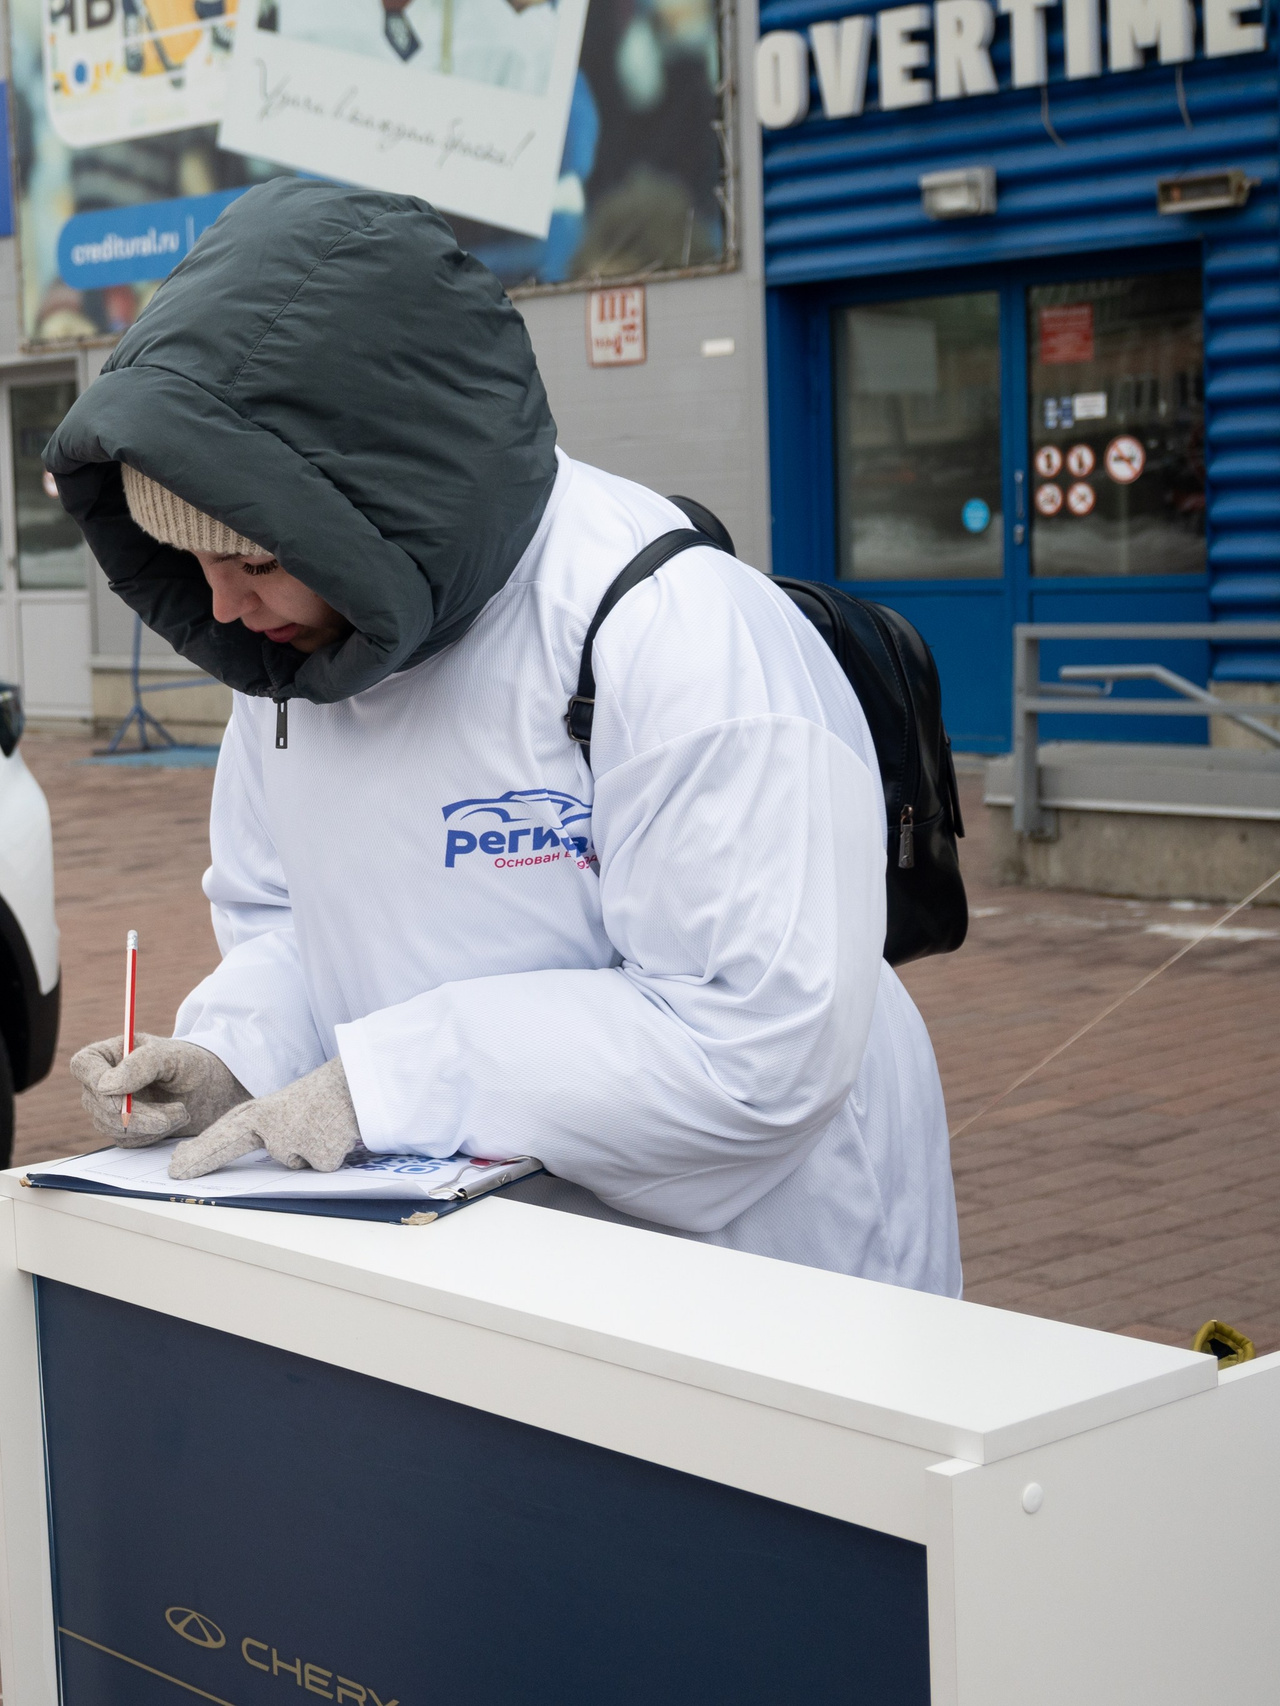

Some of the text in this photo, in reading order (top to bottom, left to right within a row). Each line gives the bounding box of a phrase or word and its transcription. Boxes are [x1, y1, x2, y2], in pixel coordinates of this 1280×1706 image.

[756, 0, 1267, 130] OVERTIME
[71, 227, 180, 266] creditural.ru
[494, 851, 560, 869] Основан
[241, 1637, 400, 1706] CHERY
